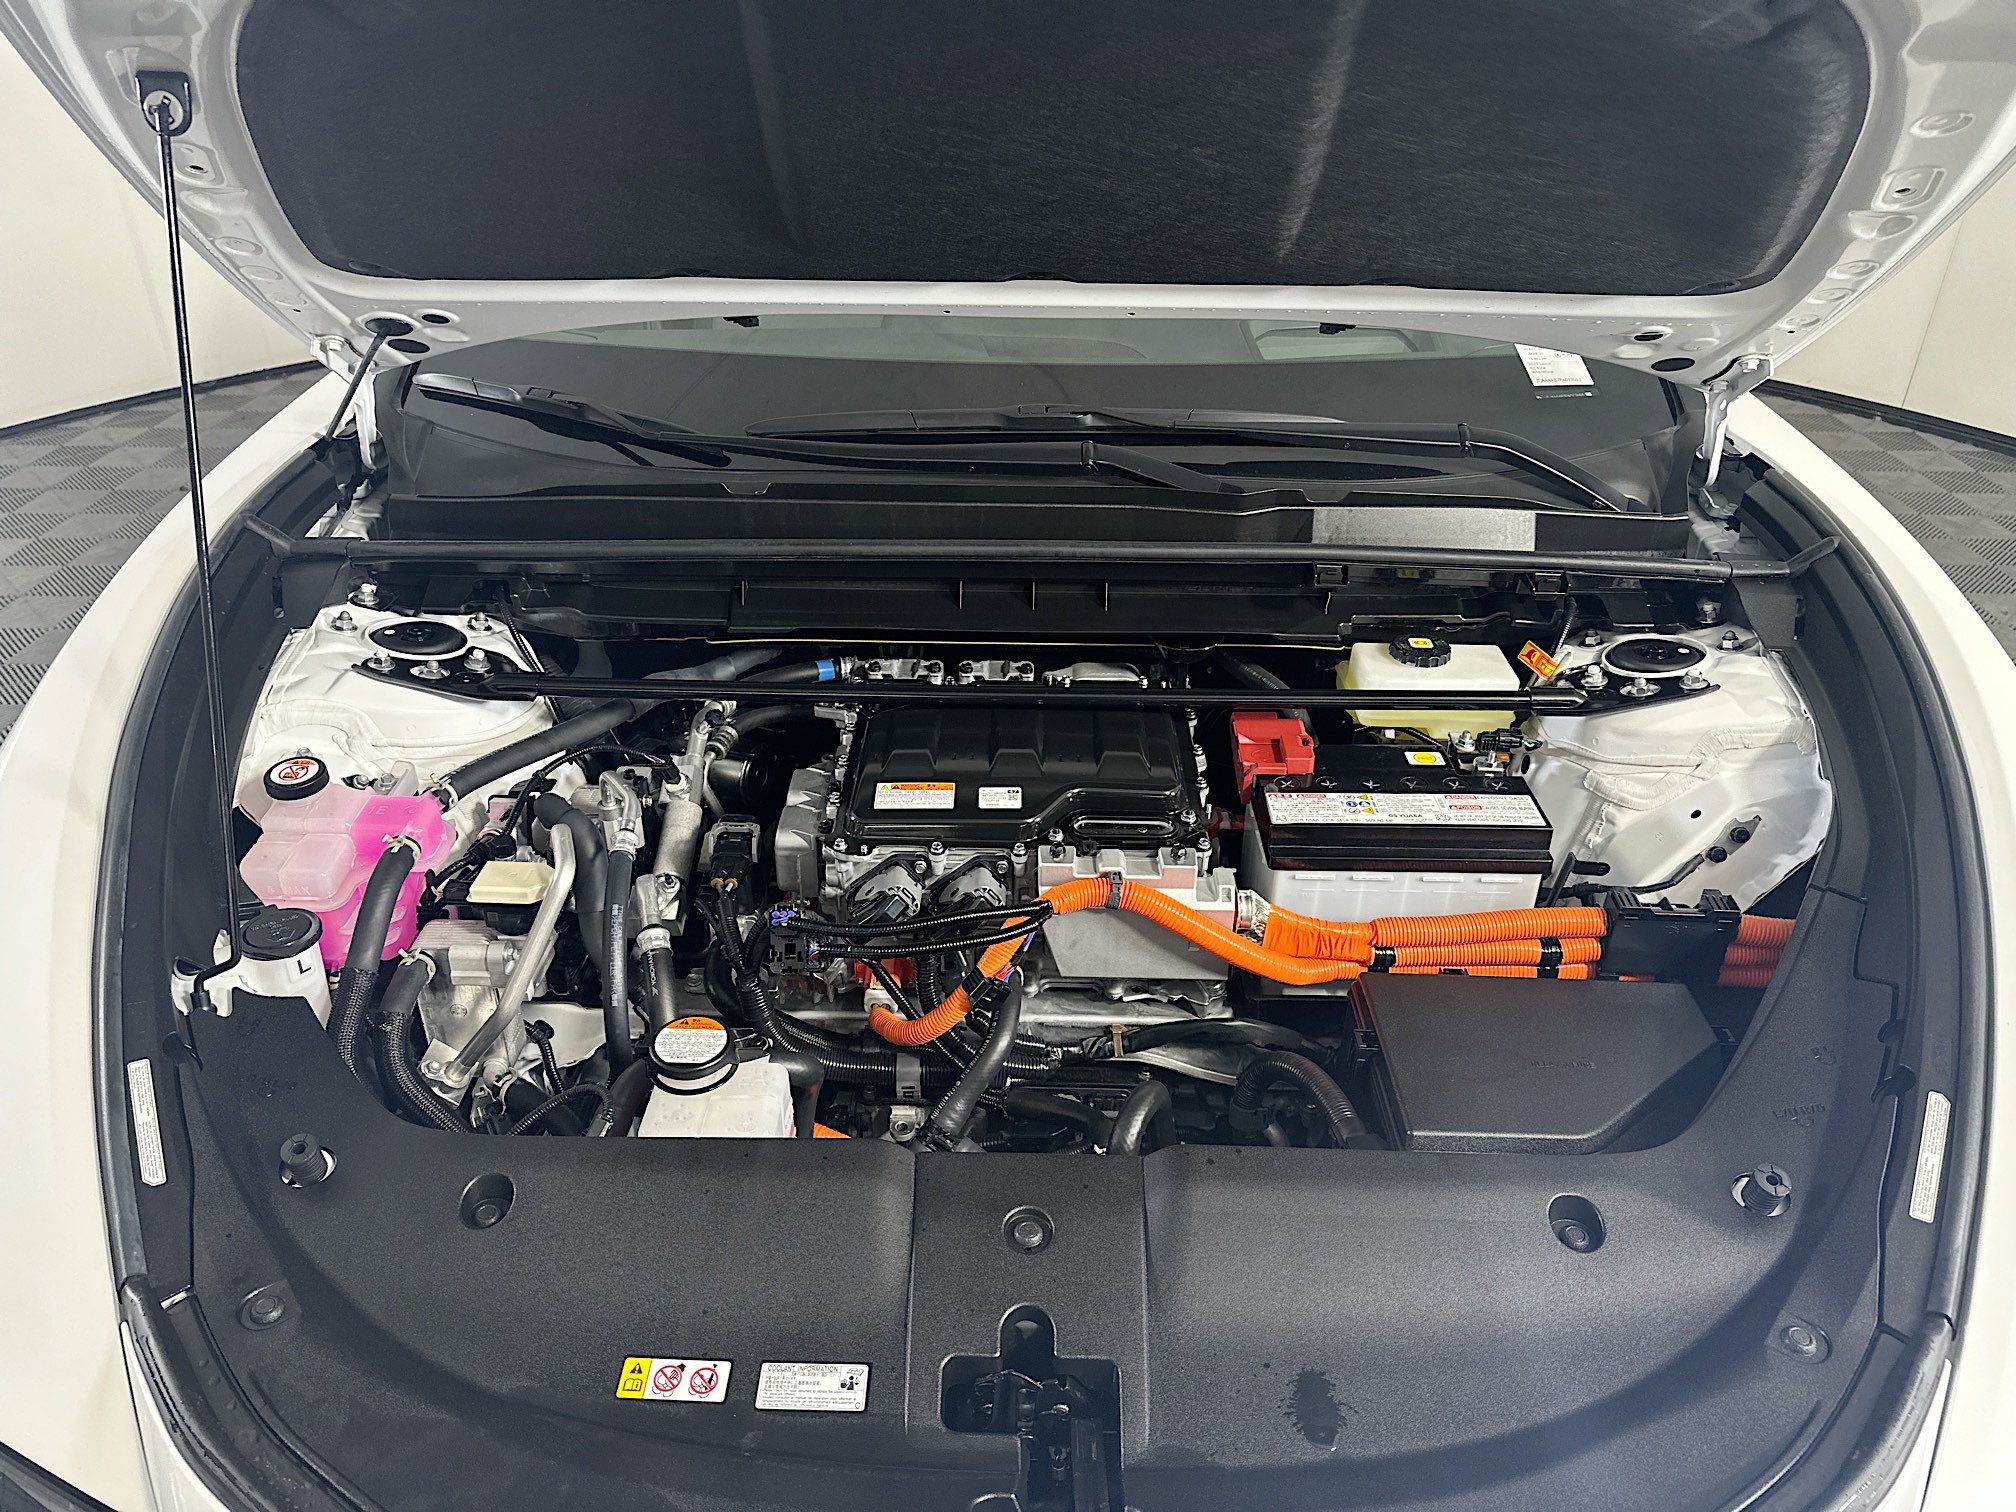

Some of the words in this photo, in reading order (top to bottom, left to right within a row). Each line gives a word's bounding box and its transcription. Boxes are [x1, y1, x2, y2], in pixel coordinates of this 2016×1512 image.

[1275, 814, 1288, 822] A3
[297, 959, 312, 974] L
[767, 1364, 796, 1372] COOLANT
